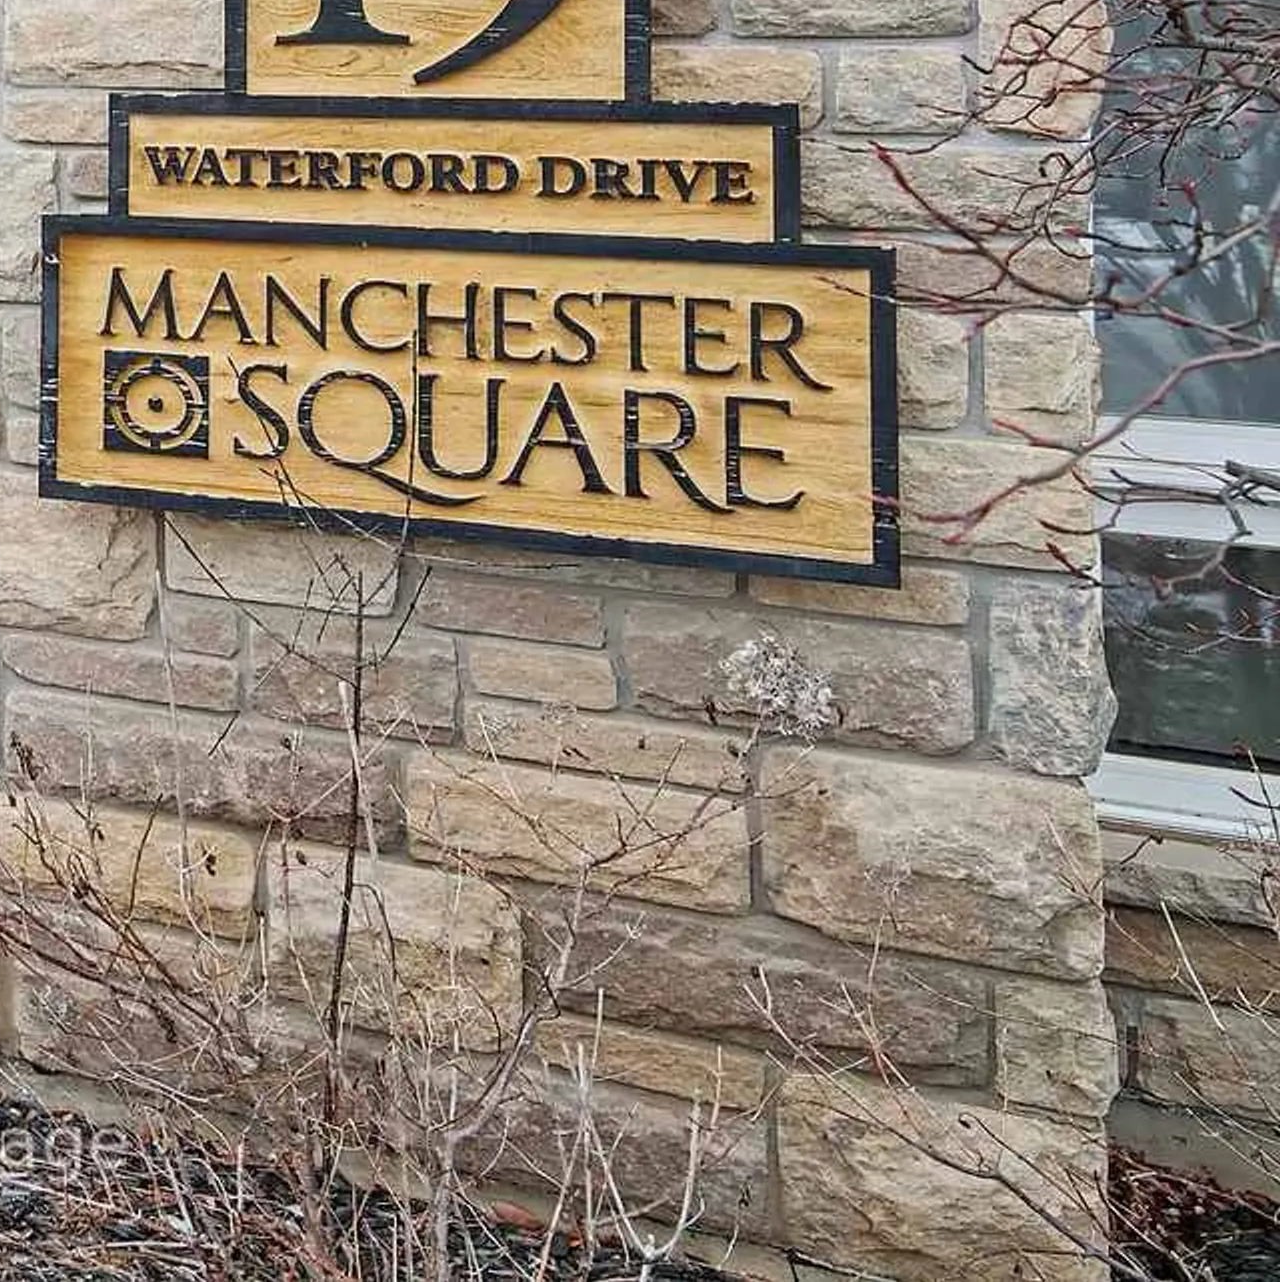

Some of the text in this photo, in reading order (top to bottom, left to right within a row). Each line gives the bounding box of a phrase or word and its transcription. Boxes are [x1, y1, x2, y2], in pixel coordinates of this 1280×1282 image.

[143, 144, 757, 207] WATERFORD DRIVE
[99, 266, 834, 392] MANCHESTER
[232, 363, 807, 515] SQUARE
